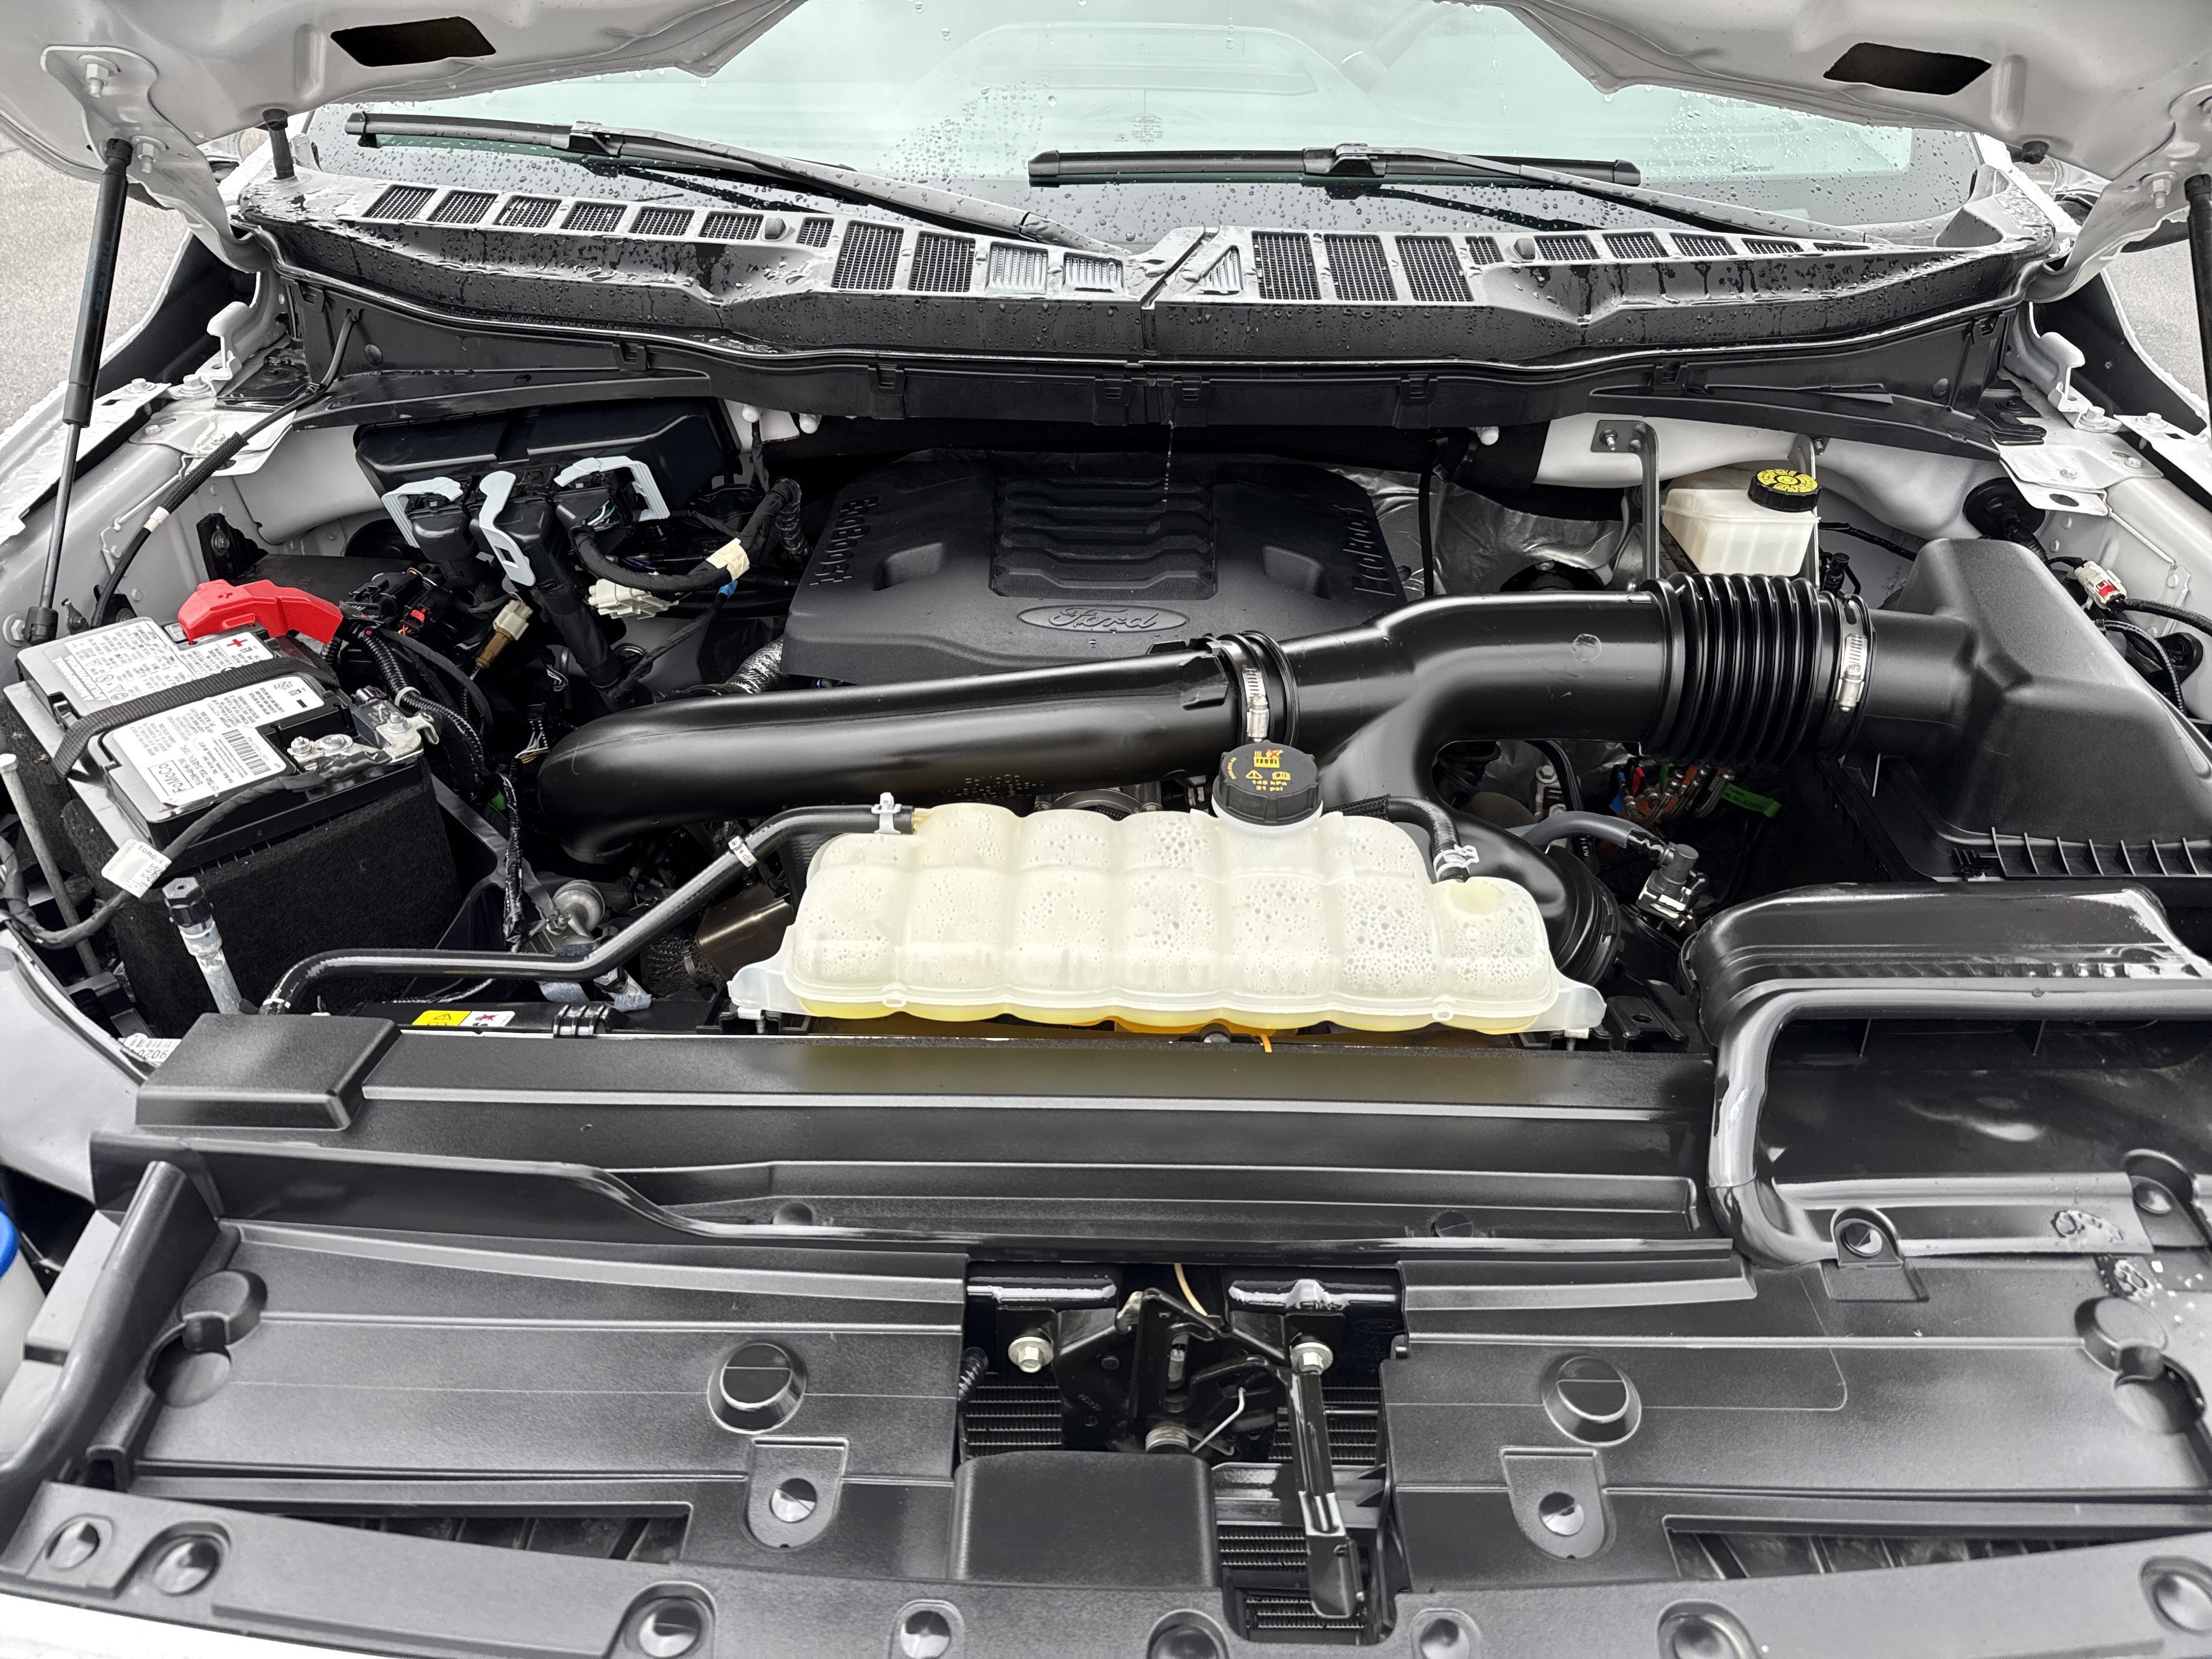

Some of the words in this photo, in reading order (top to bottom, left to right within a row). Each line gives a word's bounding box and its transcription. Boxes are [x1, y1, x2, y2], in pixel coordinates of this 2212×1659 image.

[1048, 607, 1159, 629] Ford
[158, 763, 185, 793] FoMoCo
[138, 845, 164, 865] TORQUE
